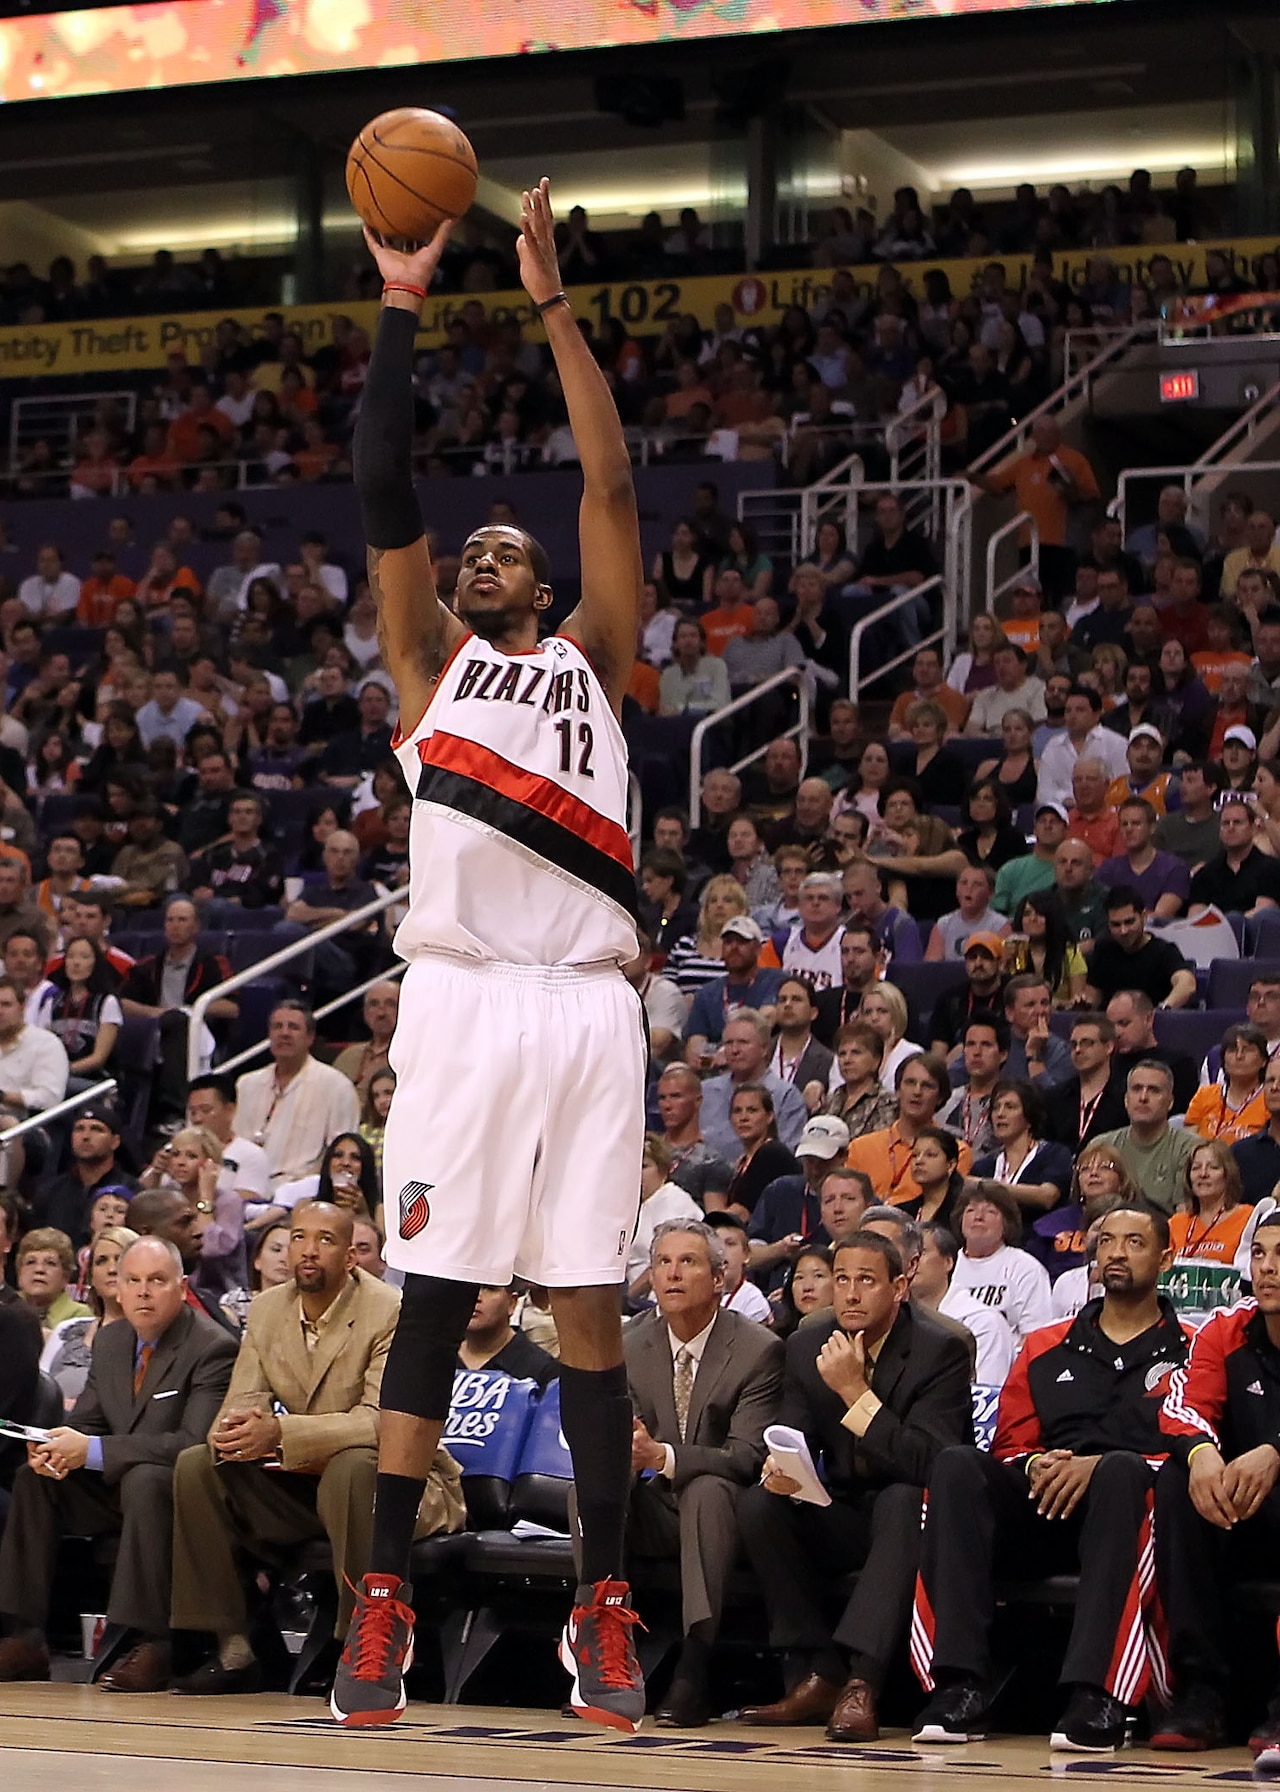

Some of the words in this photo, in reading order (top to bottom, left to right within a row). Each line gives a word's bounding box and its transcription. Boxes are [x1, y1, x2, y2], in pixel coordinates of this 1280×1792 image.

[590, 283, 681, 327] 102
[71, 324, 150, 355] Theft
[554, 718, 595, 780] 12
